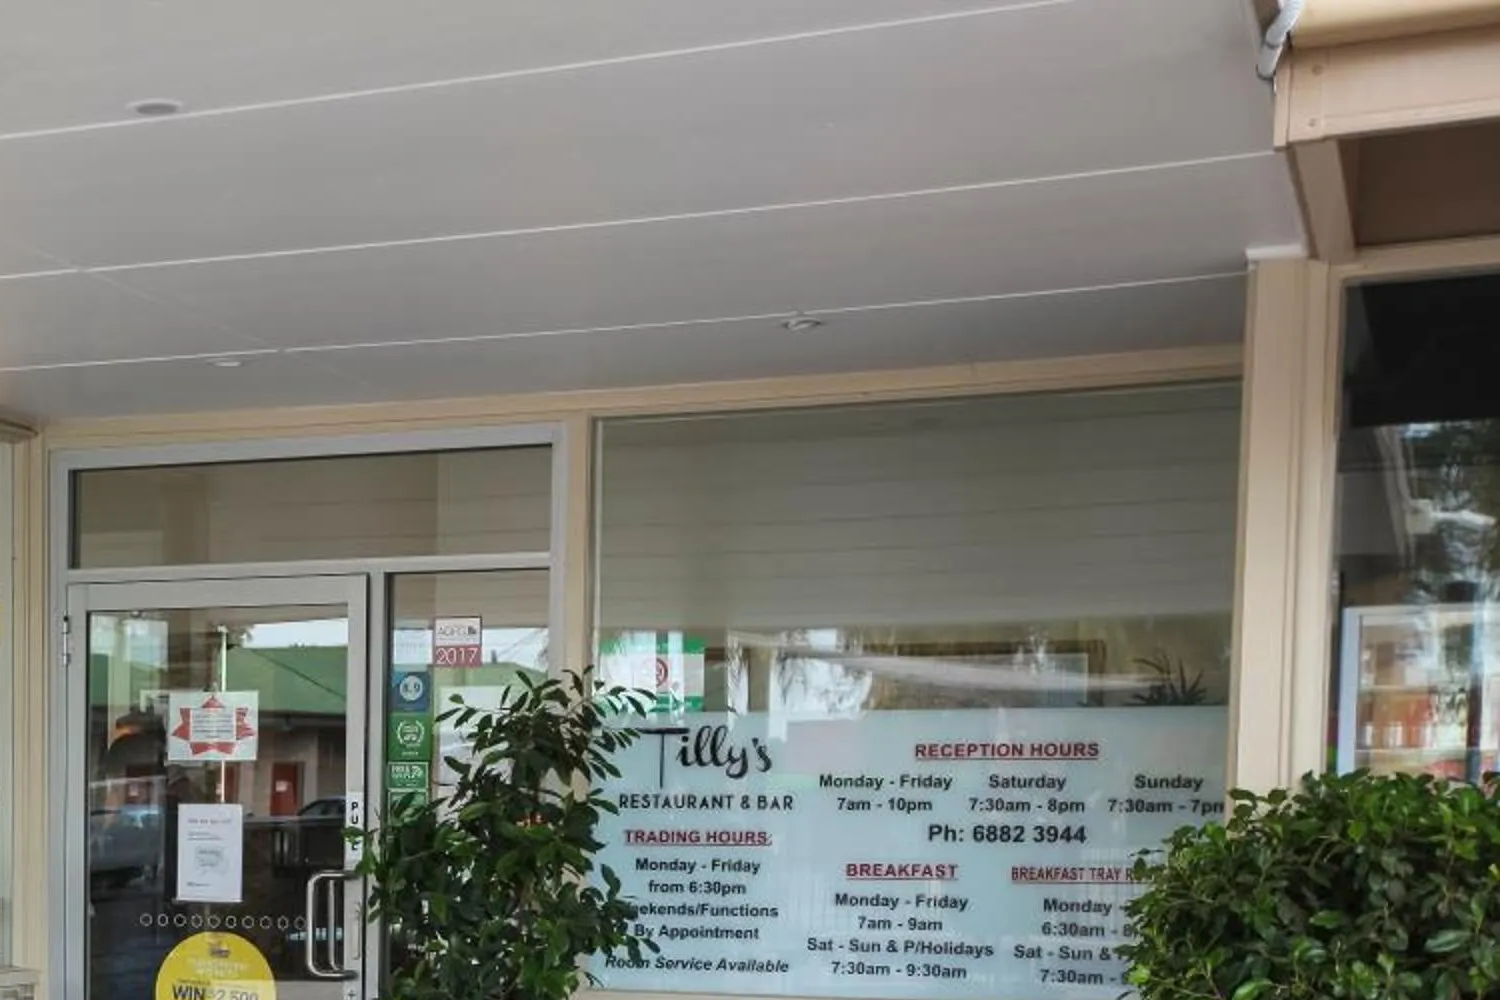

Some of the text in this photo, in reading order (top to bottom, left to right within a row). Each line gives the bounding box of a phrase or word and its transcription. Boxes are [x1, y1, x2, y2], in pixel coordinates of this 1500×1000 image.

[436, 647, 479, 665] 2017
[636, 725, 772, 788] Tilly's
[915, 743, 1100, 759] RECEPTION HOURS
[819, 774, 884, 790] Monday
[900, 775, 953, 790] Friday
[988, 775, 1067, 791] Saturday
[1134, 775, 1204, 792] Sunday
[619, 794, 793, 810] RESTAURANT & BAR
[837, 798, 871, 811] 7am
[888, 798, 933, 814] 10pm
[969, 798, 1031, 813] 7:30am
[1048, 799, 1085, 814] 8pm
[1108, 798, 1173, 813] 7:30am
[351, 802, 359, 850] PUL
[928, 825, 1087, 843] Ph: 6882 3944
[624, 830, 700, 844] TRADING
[635, 858, 696, 874] Monday
[711, 859, 760, 875] Friday
[846, 863, 958, 878] BREAKFAST
[1012, 866, 1085, 882] BREAKFAST
[1090, 867, 1121, 882] TRAY
[649, 881, 746, 897] from 6:30pm
[633, 902, 779, 918] ekends/Functions
[835, 893, 899, 910] Monday
[915, 894, 969, 911] Friday
[1043, 898, 1112, 915] Monday
[858, 916, 891, 930] 7am
[907, 918, 943, 931] 9am
[1041, 921, 1105, 937] 6:30am
[634, 924, 759, 940] By Appointment
[807, 937, 833, 951] Sat
[849, 938, 881, 953] Sun
[886, 939, 898, 953] &
[904, 940, 995, 959] P/Holidays
[1013, 944, 1042, 958] Sat
[1059, 945, 1093, 960] Sun
[1099, 946, 1111, 960] &
[655, 956, 712, 971] Service
[716, 957, 789, 973] Available
[832, 961, 890, 976] 7:30am
[906, 963, 967, 979] 9:30am
[1040, 969, 1103, 985] 7:30am
